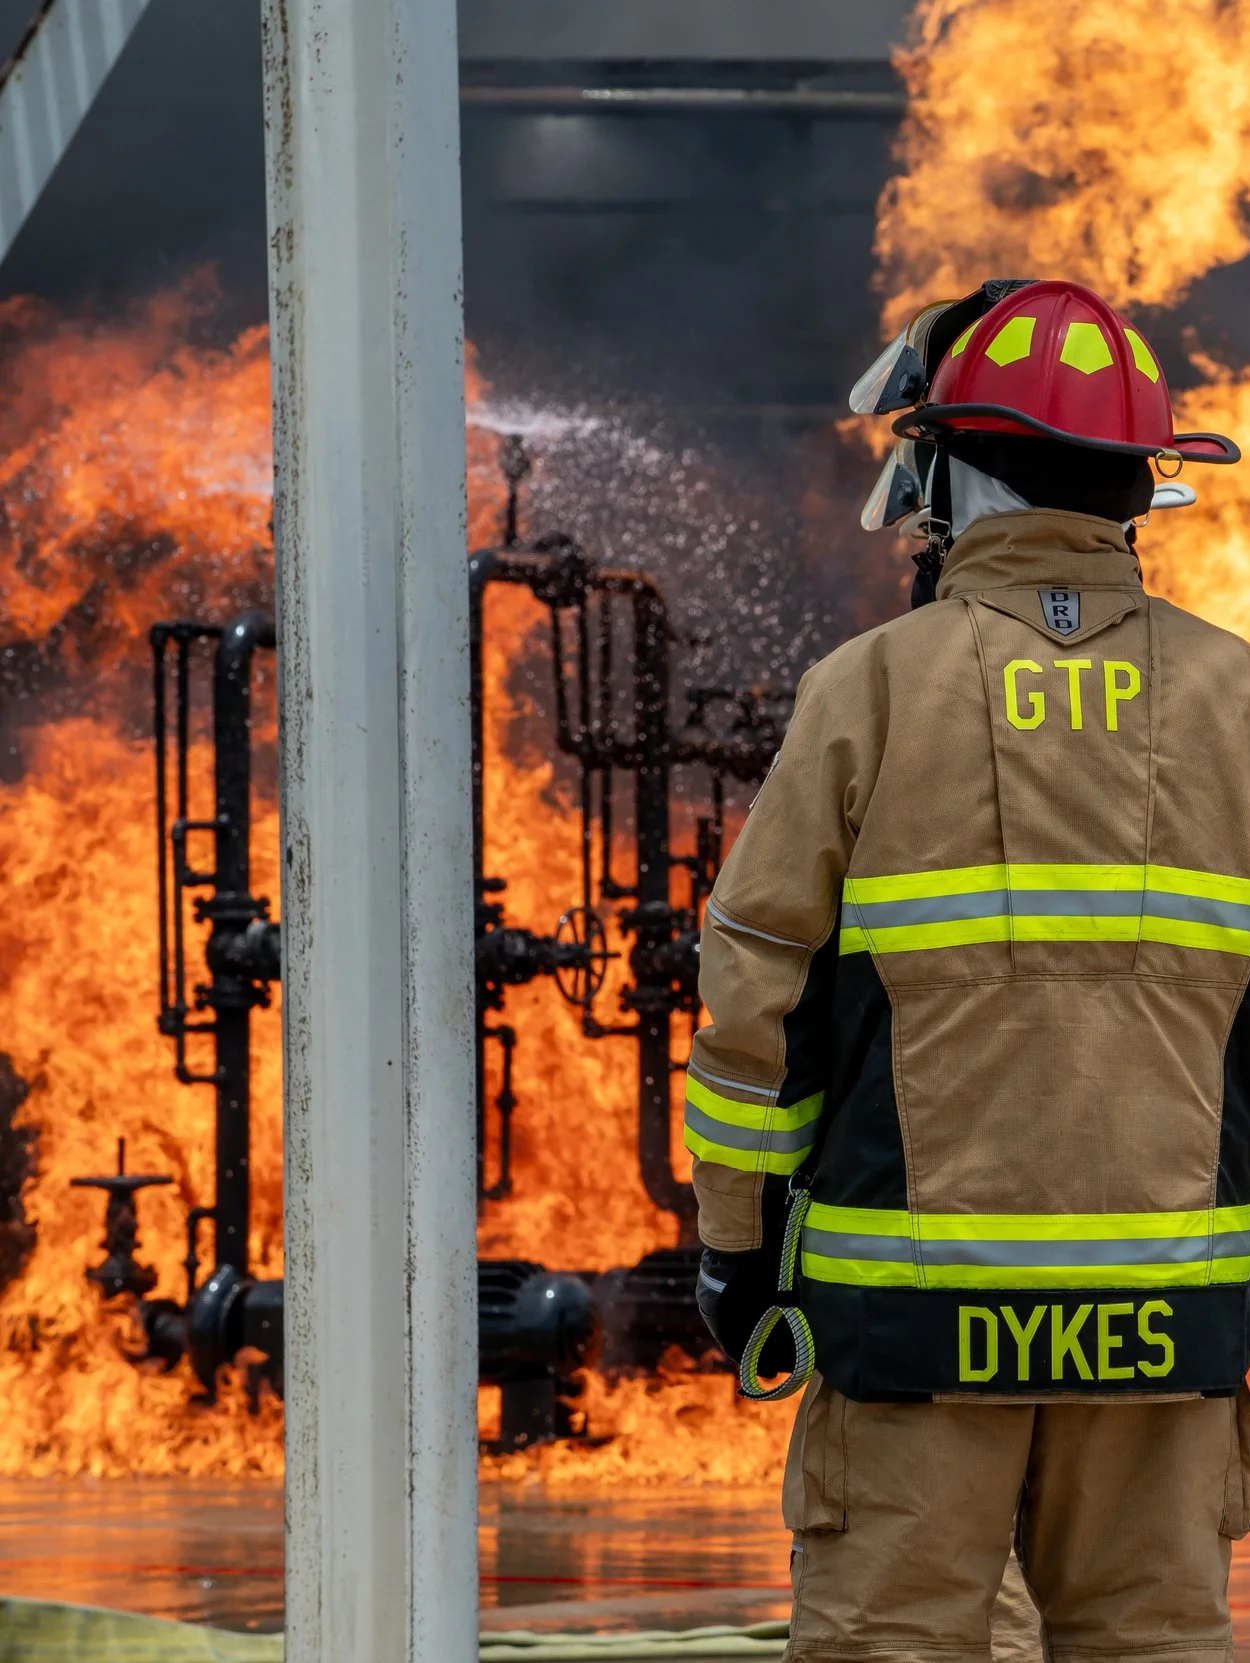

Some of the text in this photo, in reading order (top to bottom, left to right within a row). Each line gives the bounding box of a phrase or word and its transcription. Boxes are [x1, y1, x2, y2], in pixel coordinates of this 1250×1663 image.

[1051, 592, 1073, 629] DRD
[1003, 659, 1141, 731] GTP
[958, 1300, 1174, 1382] DYKES
